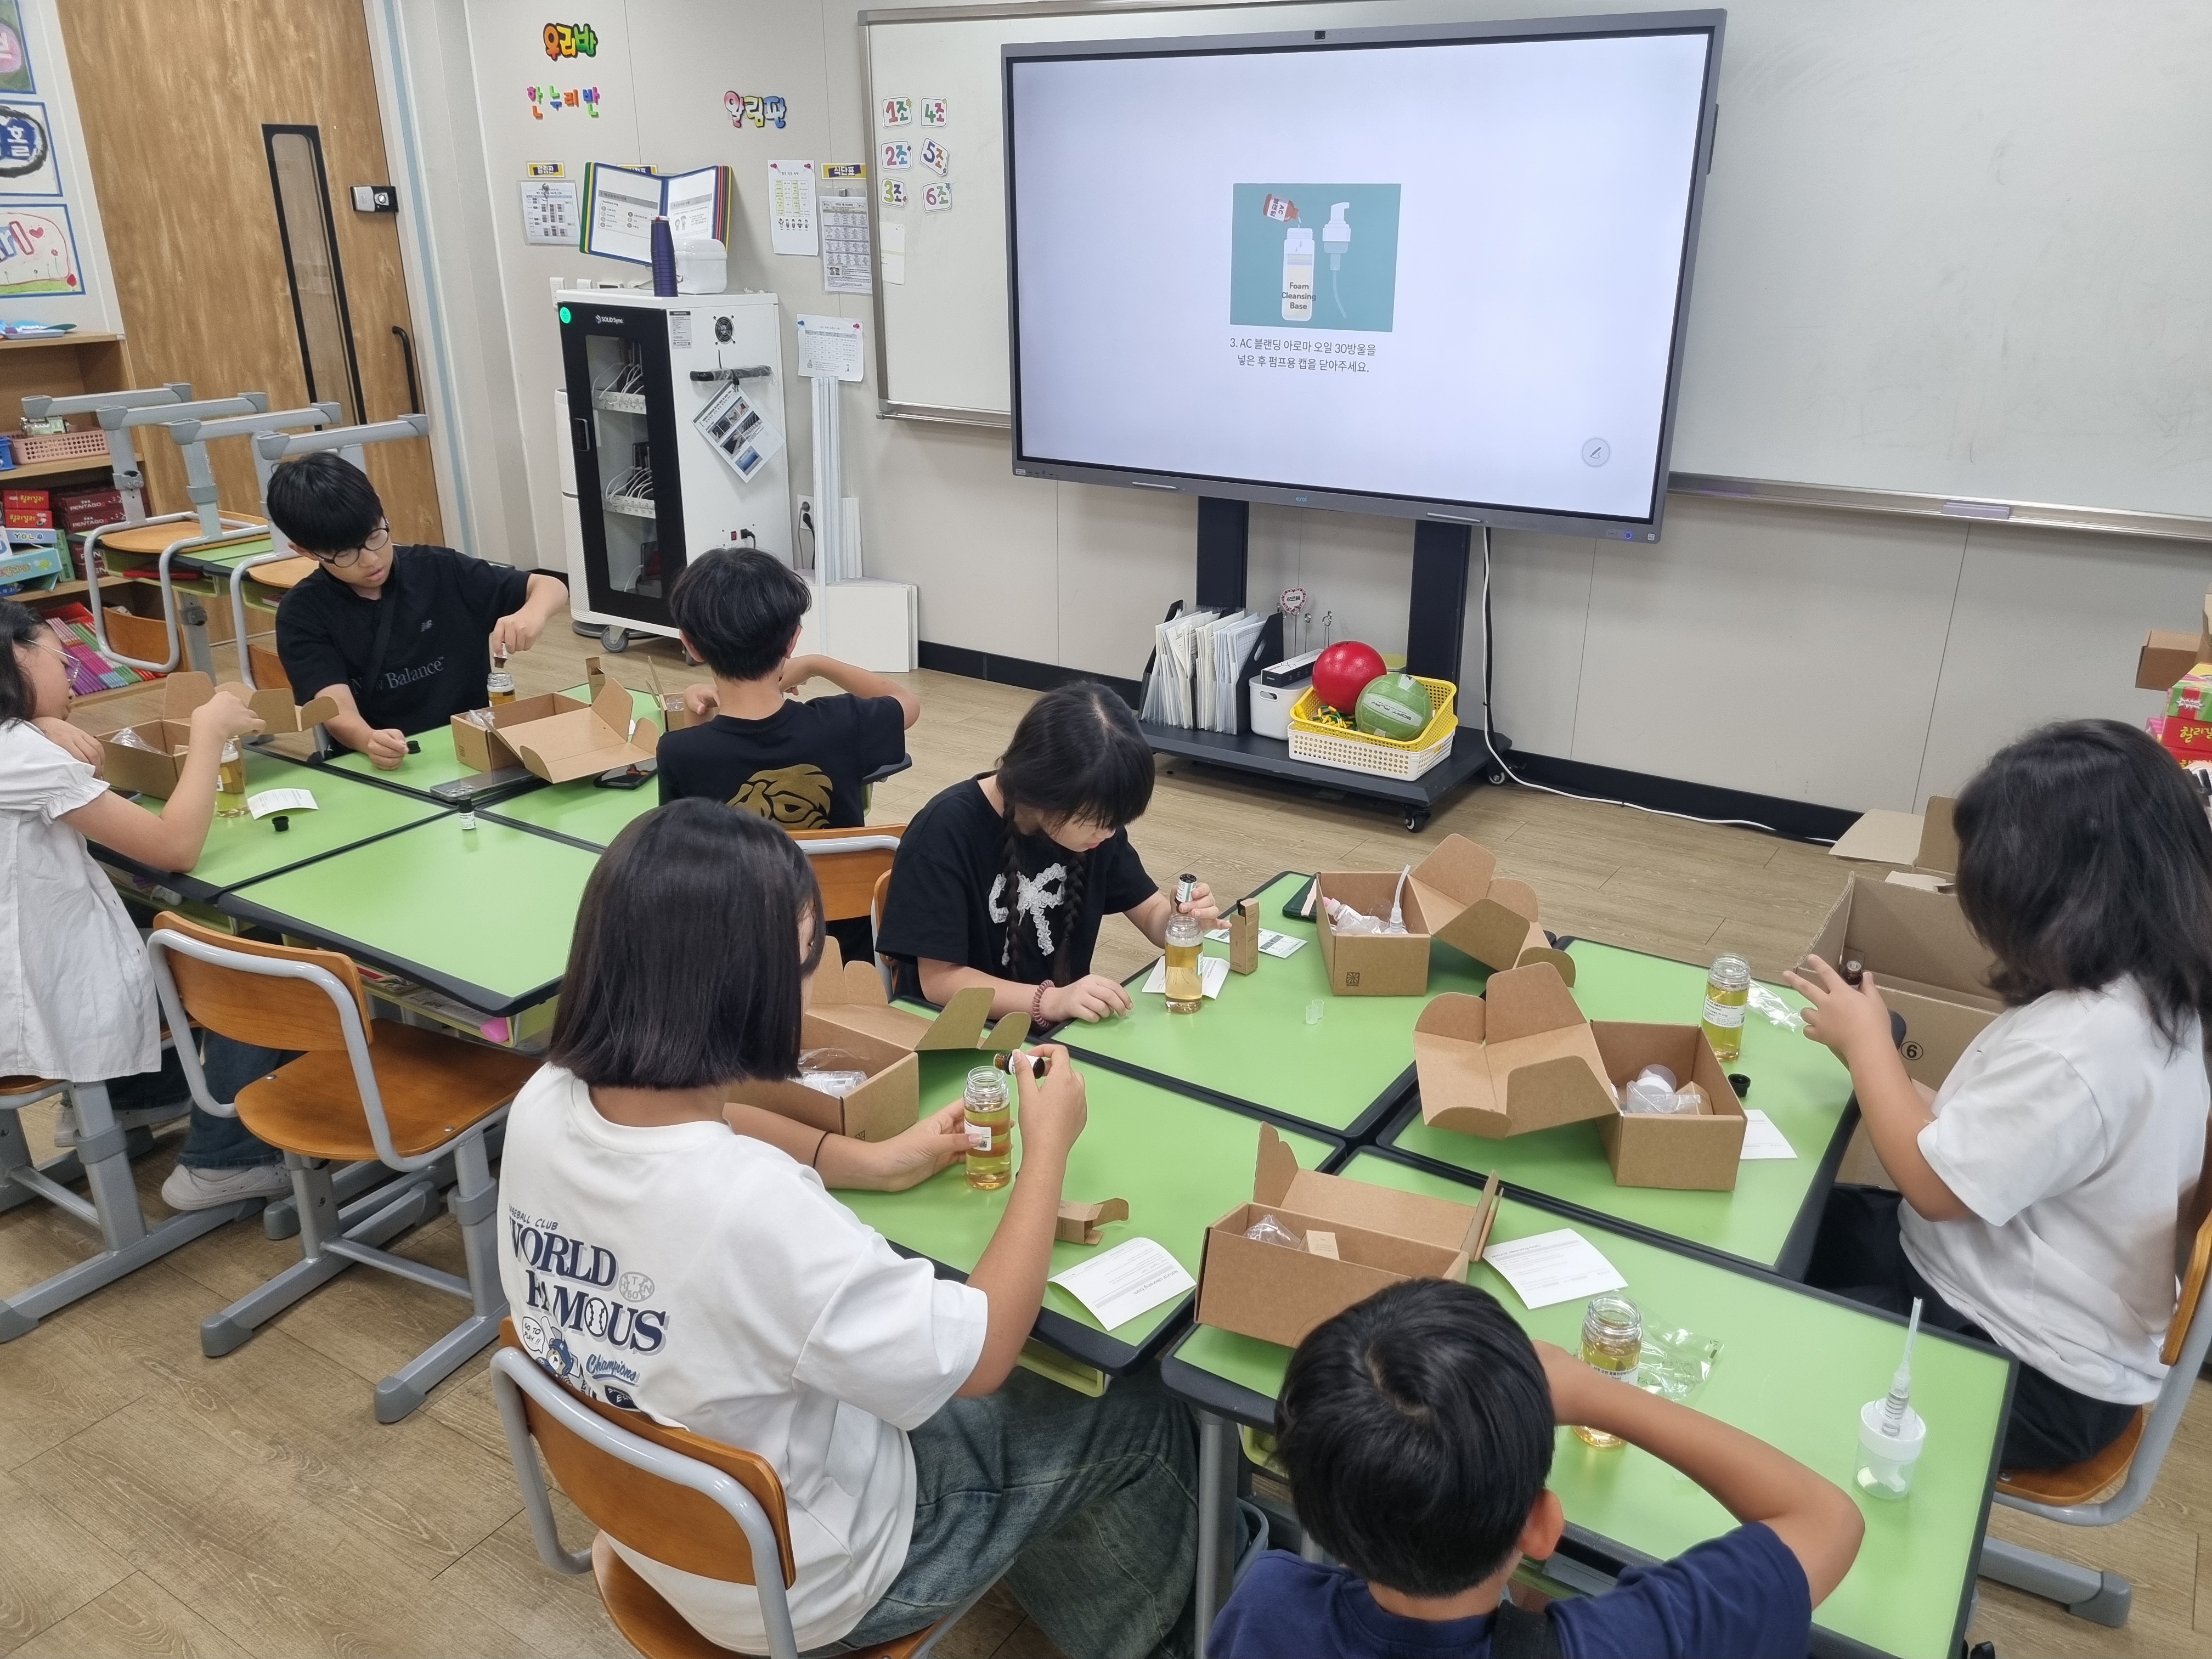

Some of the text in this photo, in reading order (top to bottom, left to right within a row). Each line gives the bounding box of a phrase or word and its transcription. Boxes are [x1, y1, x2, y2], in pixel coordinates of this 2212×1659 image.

[543, 23, 599, 62] 우리반
[724, 91, 787, 129] 알림판
[885, 101, 909, 123] 1조
[924, 103, 945, 123] 4조
[885, 145, 908, 166] 2조
[923, 140, 944, 169] 5조
[834, 166, 855, 176] 식단표
[883, 180, 902, 202] 3조
[926, 185, 949, 206] 6조
[1281, 292, 1317, 301] Cleansing
[1229, 338, 1376, 356] 3. AC 블랜딩 아로마 오일 30방울을
[1238, 354, 1369, 373] 넣은 후 펌프용 캡을 닫아주세요.
[70, 502, 101, 511] PENTAGO
[72, 518, 104, 527] PENTAGO
[385, 660, 443, 689] Balance
[535, 1218, 558, 1231] CLUB
[510, 1215, 617, 1286] WORLD
[524, 1331, 534, 1342] PLAY
[586, 1353, 637, 1382] Champions
